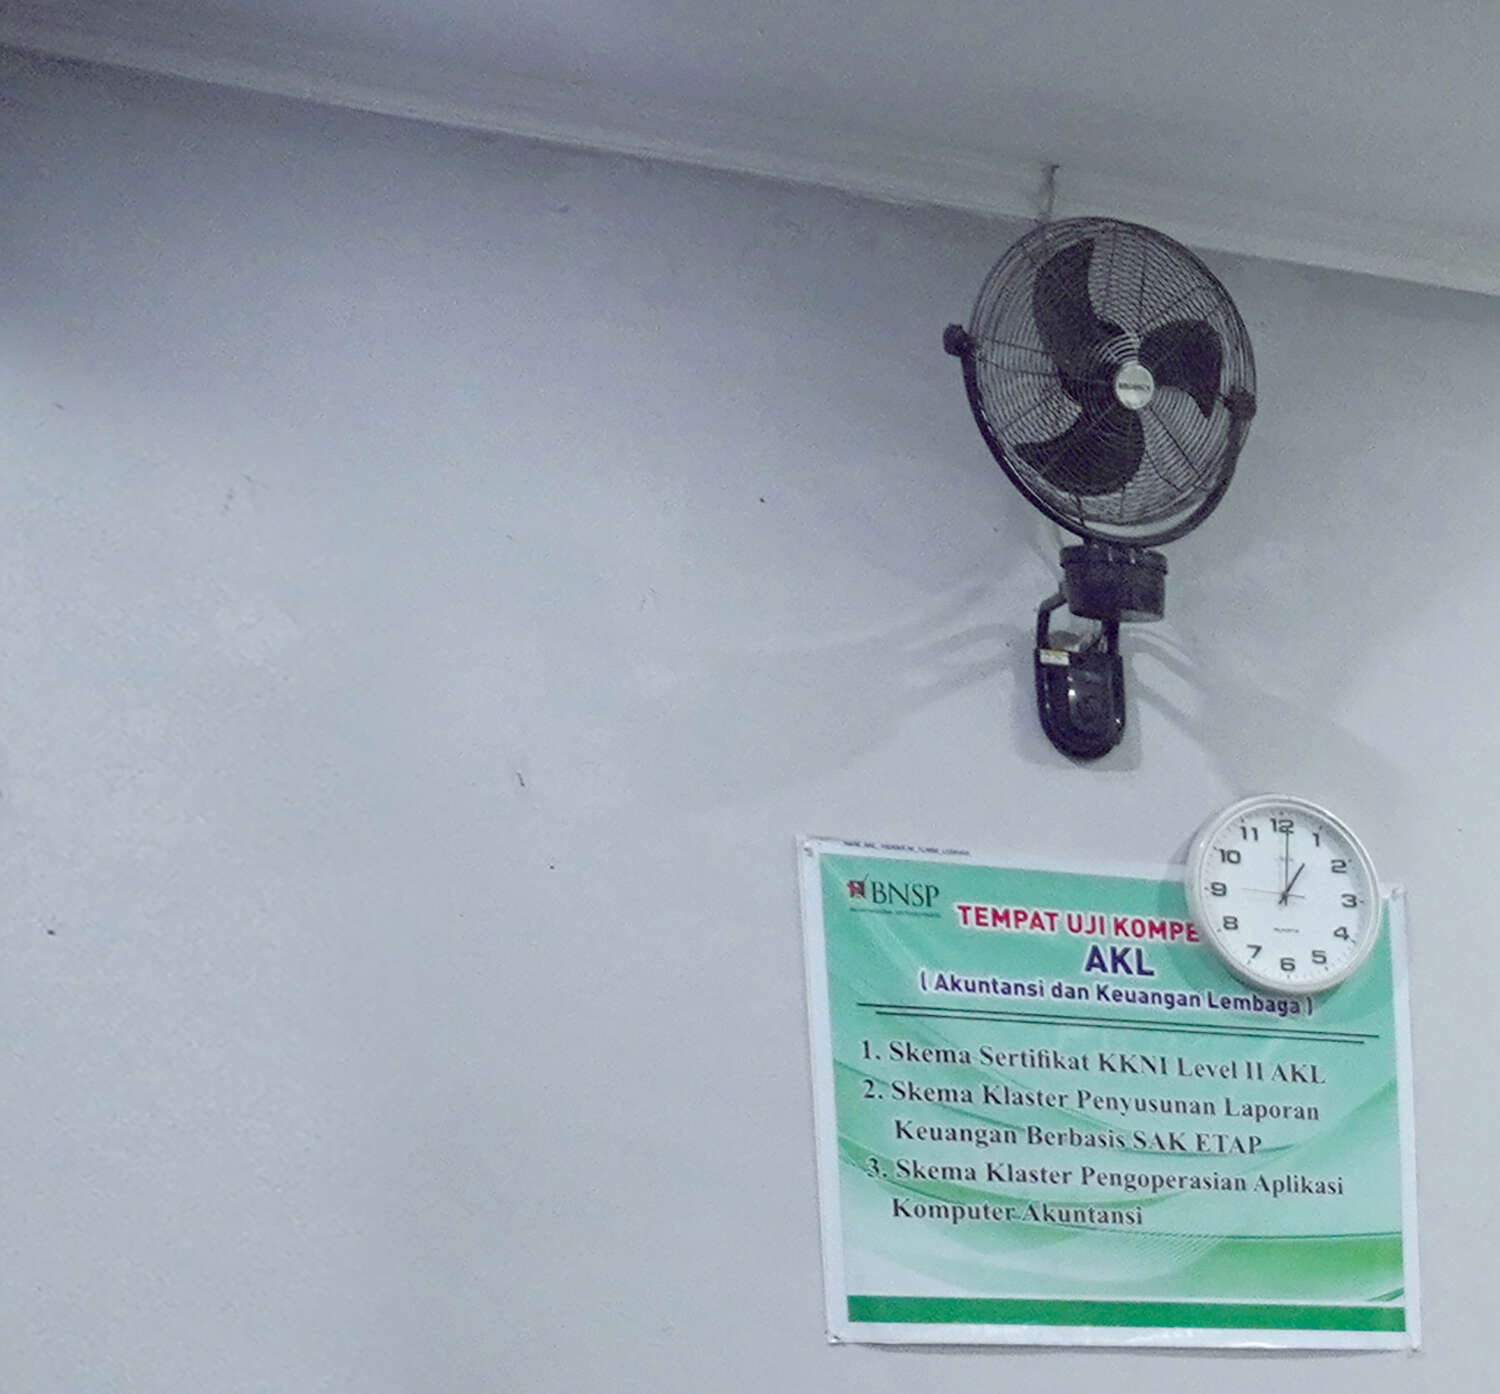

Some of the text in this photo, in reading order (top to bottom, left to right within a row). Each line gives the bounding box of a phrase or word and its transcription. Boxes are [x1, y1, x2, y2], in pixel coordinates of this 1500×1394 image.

[1240, 826, 1258, 842] 11
[1270, 818, 1294, 834] 12
[1220, 849, 1241, 864] 10
[1331, 859, 1347, 873] 2
[871, 881, 940, 908] BNSP
[1211, 882, 1227, 897] 9
[1341, 894, 1358, 908] 3
[957, 905, 1058, 931] TEMPAT
[1067, 916, 1105, 936] UJI
[1114, 920, 1200, 943] KOMPE
[1223, 916, 1239, 931] 8
[1333, 927, 1349, 941] 4
[1247, 945, 1262, 959] 7
[1312, 950, 1327, 964] 5
[1085, 945, 1155, 977] AKL
[1280, 957, 1296, 972] 6
[935, 975, 1045, 998] Akuntansi
[1052, 980, 1089, 1000] dan
[1097, 985, 1201, 1011] Keuangan
[1208, 990, 1301, 1016] Lembaga
[862, 1040, 881, 1060] 1.
[889, 1041, 971, 1065] Skema
[980, 1046, 1089, 1072] Sertifikat
[1098, 1053, 1168, 1075] KKNI
[1177, 1057, 1237, 1080] Level
[1271, 1063, 1327, 1085] AKL
[864, 1079, 1320, 1123] 2. Skema Klaster Penyusunan Laporan
[895, 1119, 1262, 1154] Keuangan Berbasis SAK ETAP
[867, 1157, 1344, 1198] 3. Skema Klaster Pengoperasian Aplikasi
[892, 1198, 1143, 1226] Komputer Akuntansi
